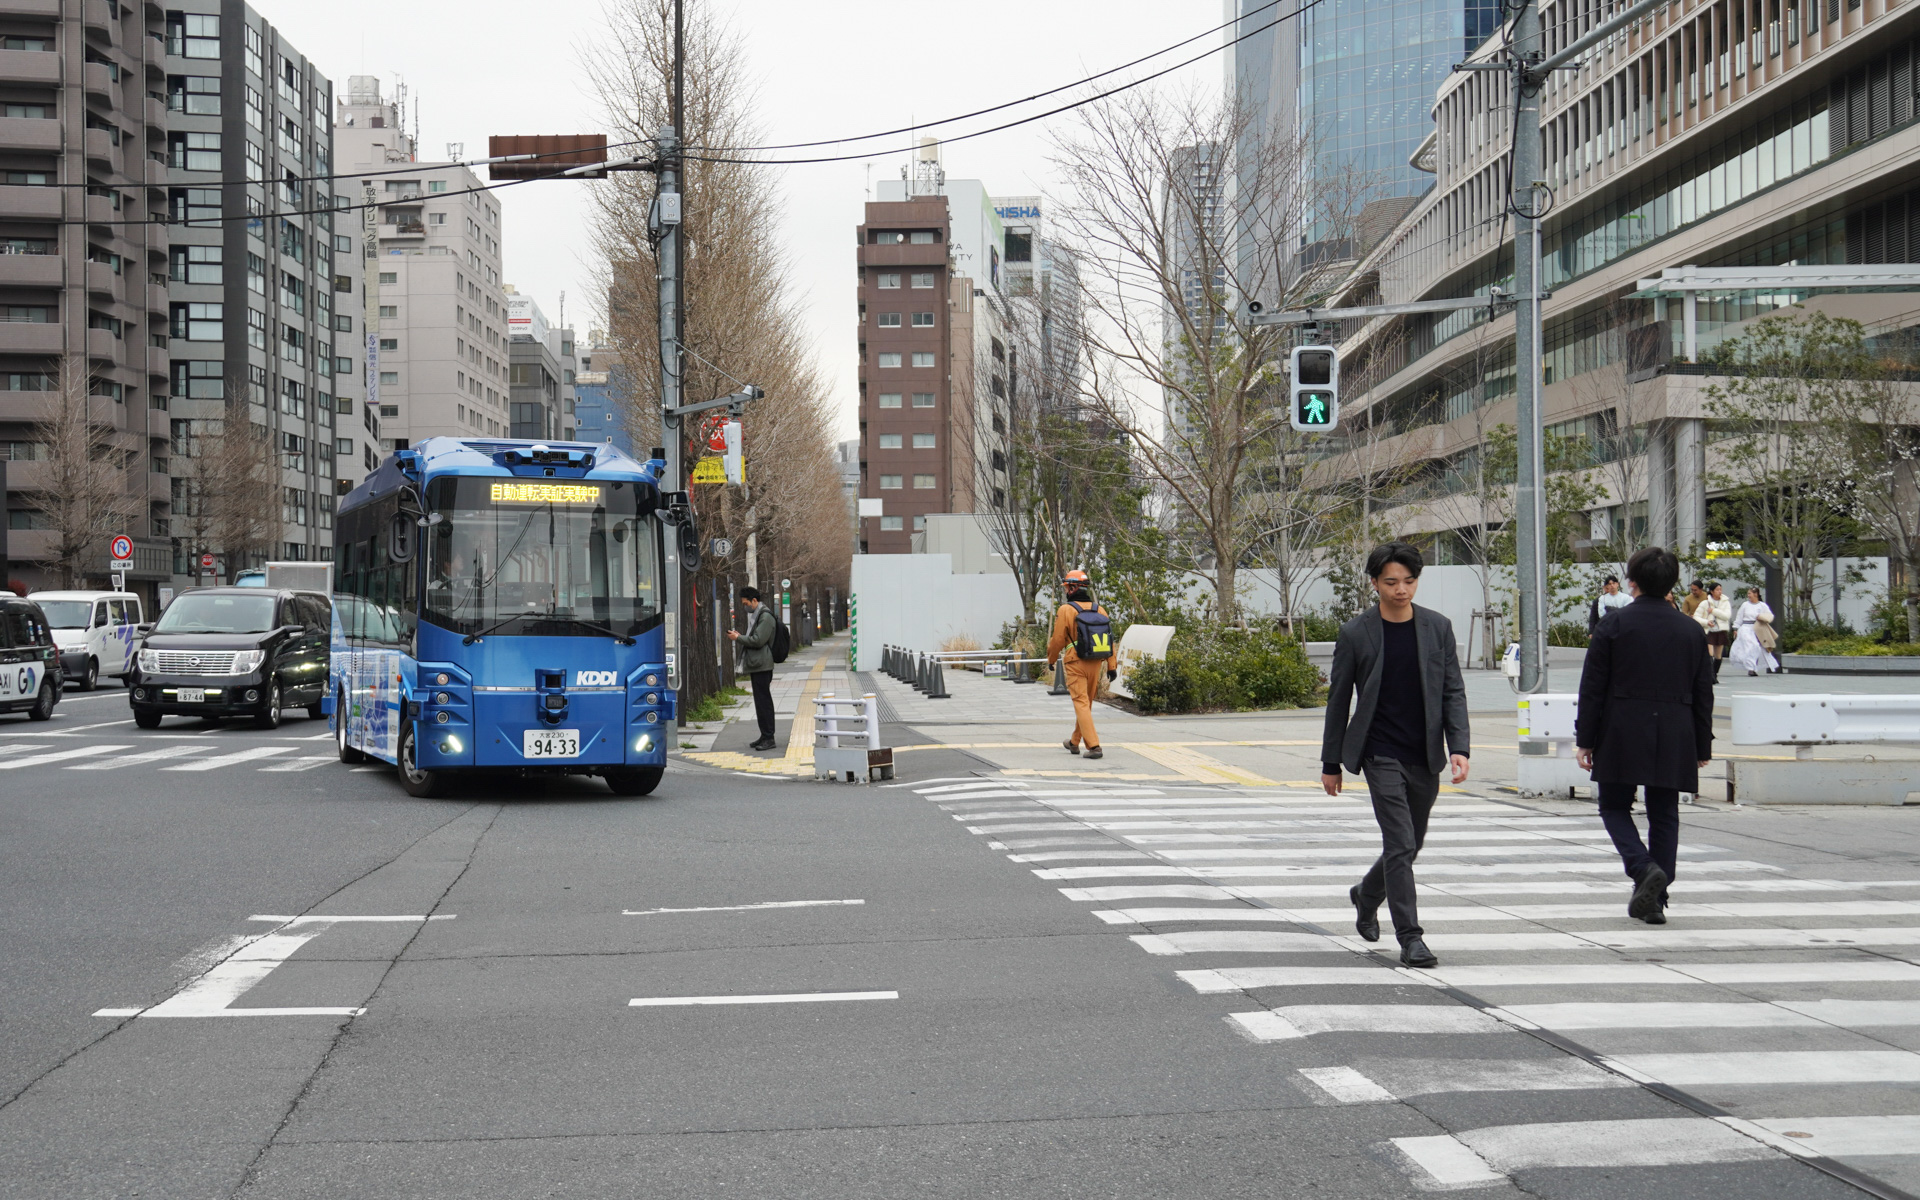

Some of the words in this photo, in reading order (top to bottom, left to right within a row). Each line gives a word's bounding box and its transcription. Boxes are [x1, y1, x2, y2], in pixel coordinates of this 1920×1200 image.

[491, 483, 600, 502] 自動運転実証実験中
[576, 670, 618, 685] KDDI
[183, 693, 203, 701] 87-44
[534, 739, 577, 755] 94-33
